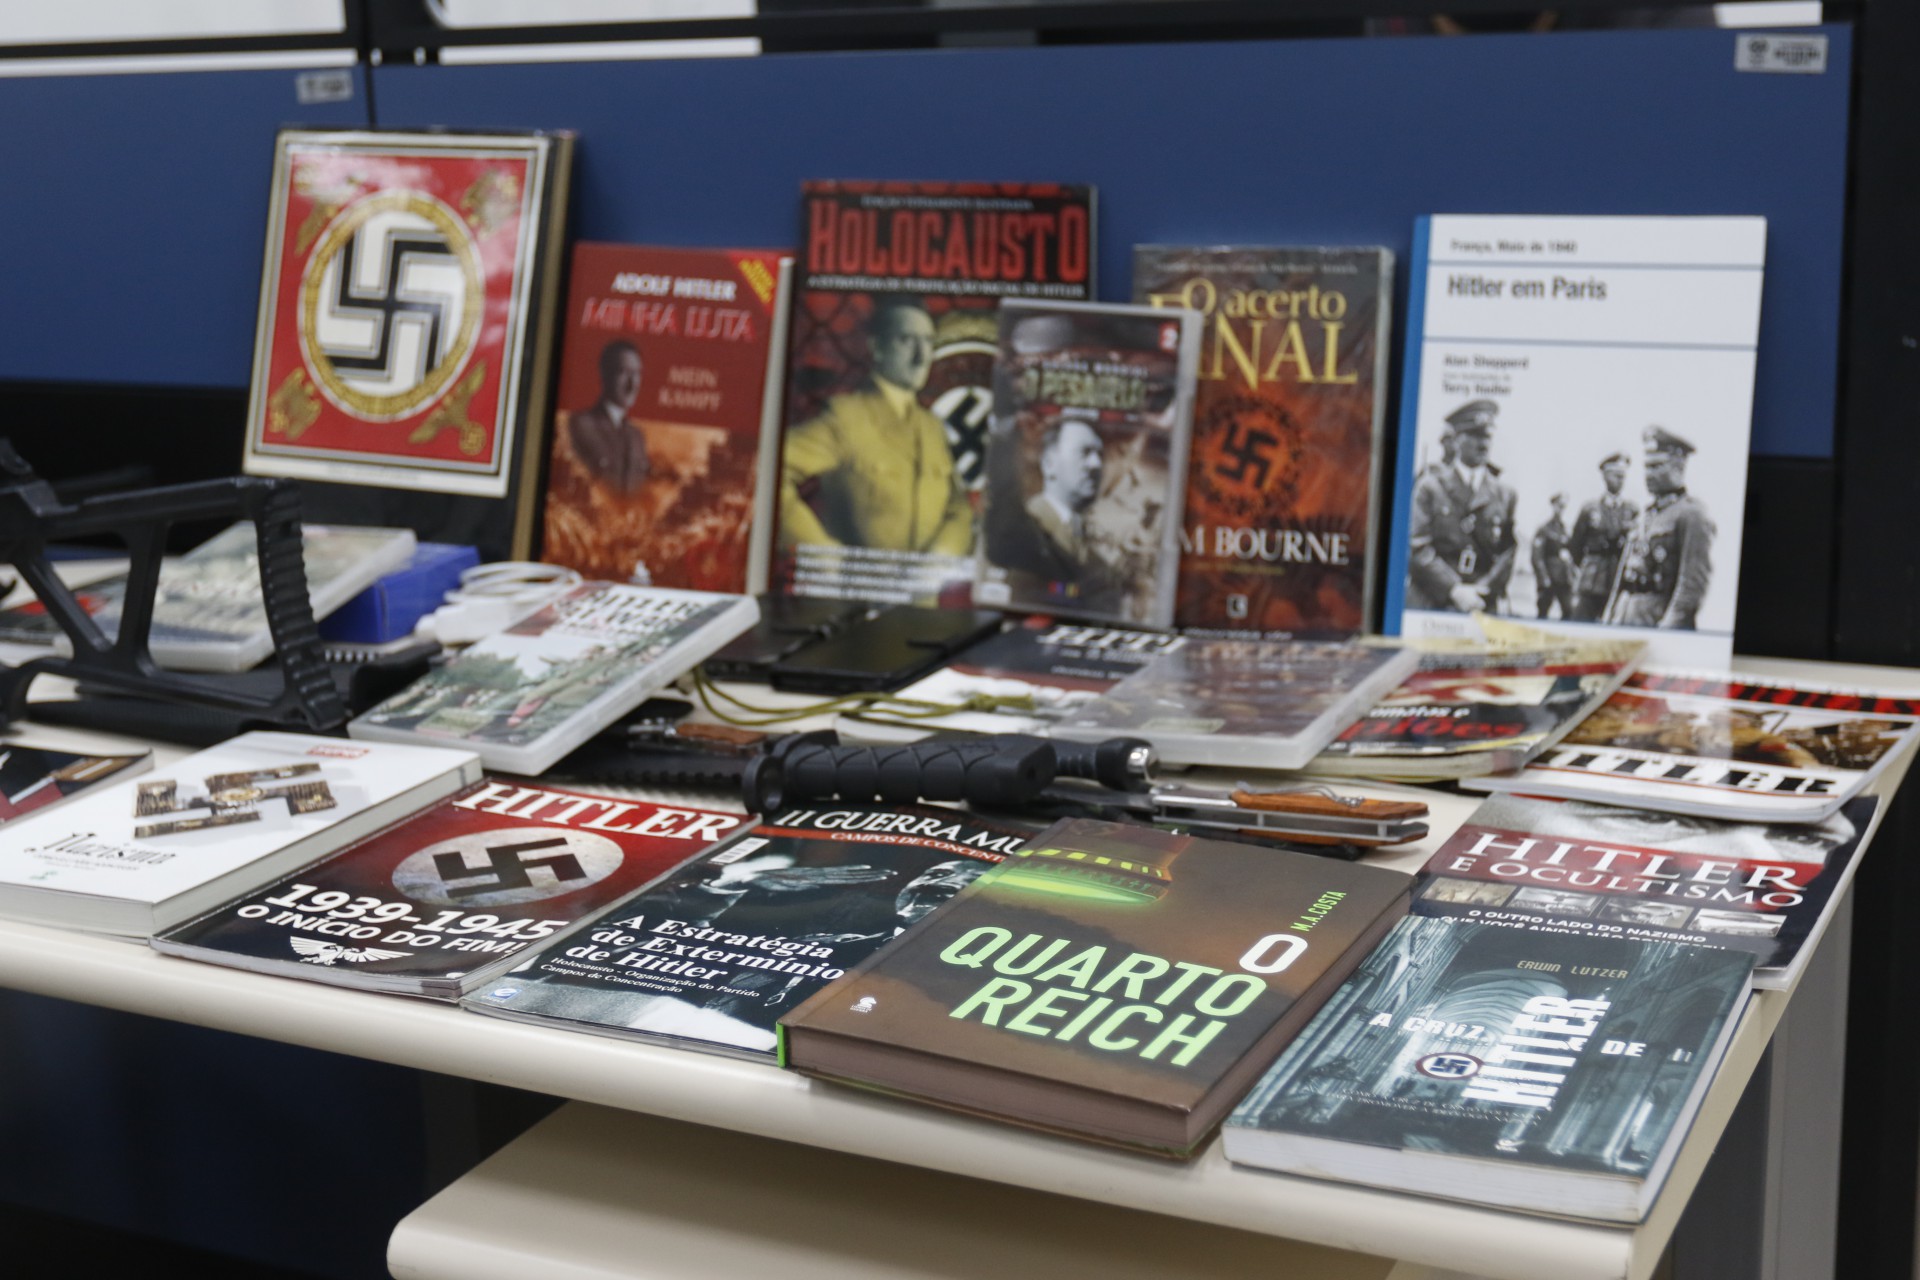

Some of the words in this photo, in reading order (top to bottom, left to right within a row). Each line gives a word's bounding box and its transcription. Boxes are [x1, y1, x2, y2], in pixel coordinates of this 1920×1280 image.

[808, 201, 1087, 282] HOLOCAUSTO
[612, 272, 671, 296] ADOLF
[673, 276, 737, 301] HITLER
[1182, 277, 1216, 317] O
[1224, 282, 1347, 320] acerto
[1448, 274, 1503, 297] Hitler
[1511, 280, 1545, 298] em
[1552, 276, 1607, 300] Paris
[1215, 526, 1349, 565] BOURNE
[452, 782, 740, 841] HITLER
[774, 809, 816, 828] II
[814, 810, 961, 842] GUERRA
[831, 831, 898, 845] CAMPOS
[898, 834, 921, 847] DE
[1449, 856, 1477, 872] E
[1488, 862, 1803, 907] OCULTISMO
[1462, 831, 1807, 892] HITLER
[237, 904, 269, 919] O
[266, 909, 383, 940] INÍCIO
[381, 930, 442, 947] DO
[441, 938, 528, 956] FIM!
[265, 883, 570, 941] 1939-1945
[1468, 909, 1481, 918] O
[1484, 911, 1544, 924] OUTRO
[1546, 918, 1593, 930] LADO
[1597, 923, 1623, 933] DO
[1626, 928, 1706, 943] NAZISMO
[591, 927, 640, 946] de
[639, 936, 845, 981] Extermínio
[613, 914, 646, 930] A
[648, 917, 834, 959] Estratégia
[1238, 934, 1308, 973] O
[540, 963, 585, 978] Campos
[587, 971, 603, 980] de
[604, 974, 682, 993] Concentração
[550, 957, 614, 974] Holocausto
[624, 969, 697, 988] Organização
[698, 982, 714, 990] do
[717, 985, 760, 998] Partido
[565, 943, 611, 961] de
[612, 951, 728, 981] Hitler
[939, 926, 1268, 1017] QUARTO
[1516, 960, 1561, 973] ERWIN
[1570, 965, 1629, 979] LUTZER
[949, 976, 1227, 1067] REICH
[1369, 1012, 1393, 1028] A
[1402, 1016, 1484, 1039] CRUZ
[1461, 996, 1611, 1108] HITLER
[1601, 1039, 1647, 1057] DE
